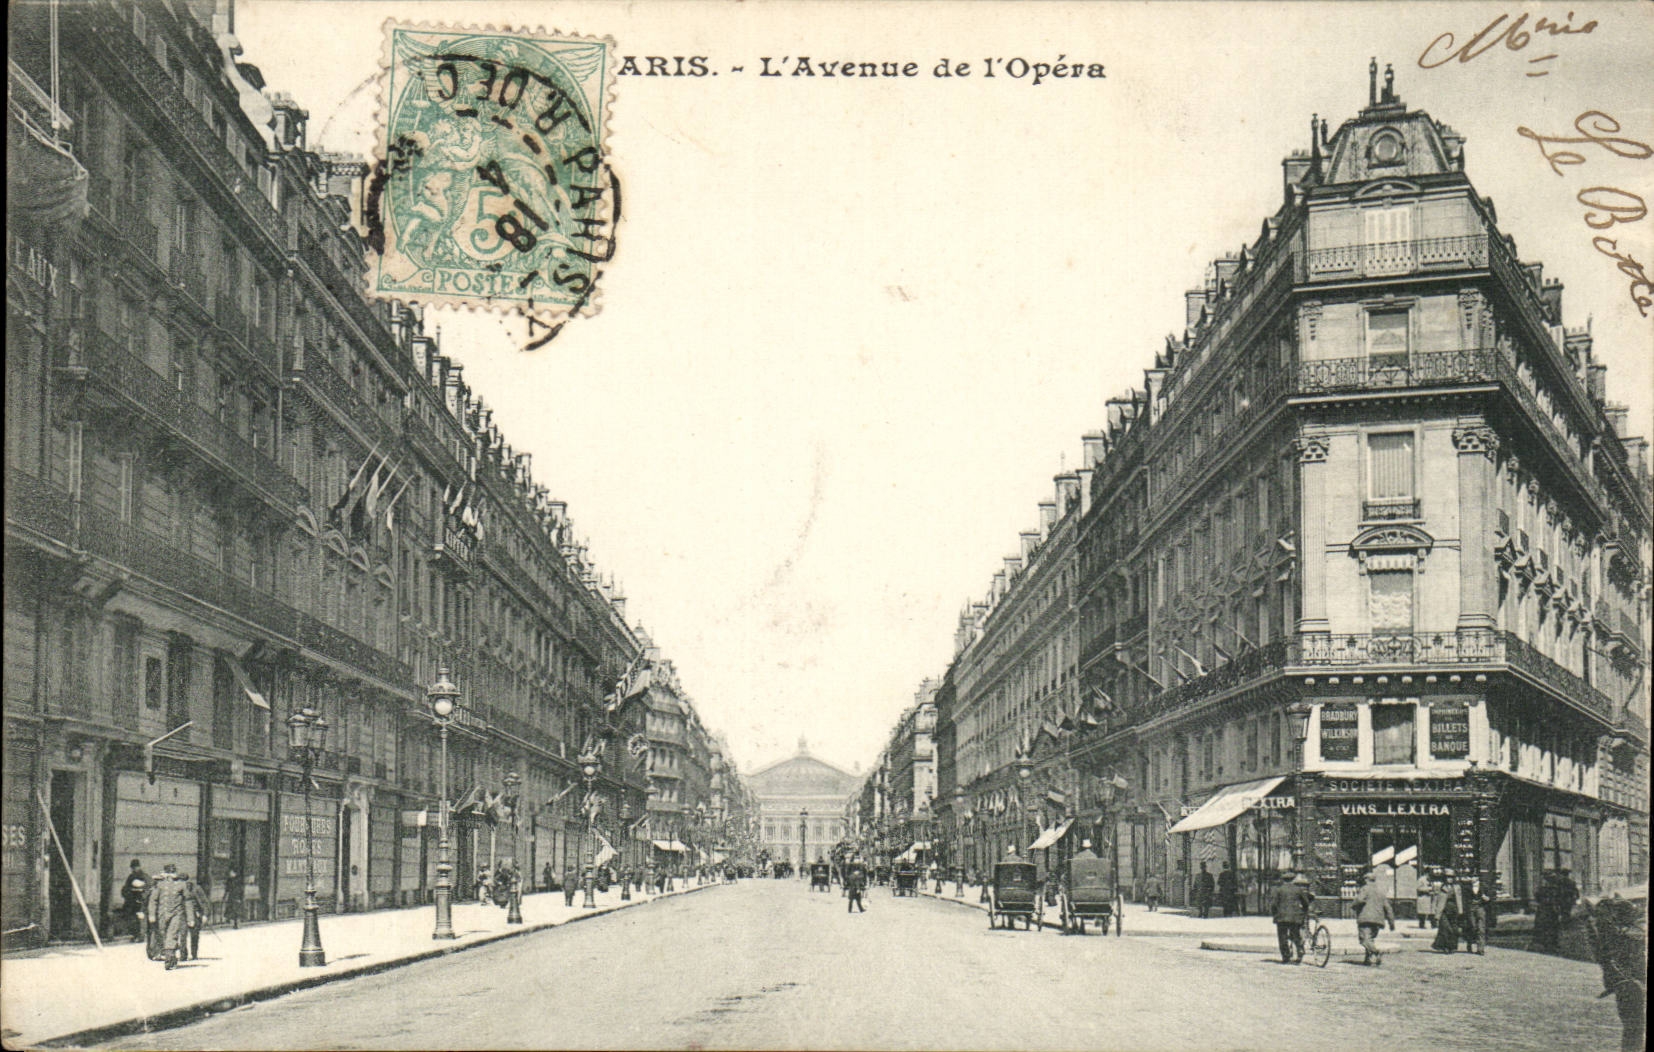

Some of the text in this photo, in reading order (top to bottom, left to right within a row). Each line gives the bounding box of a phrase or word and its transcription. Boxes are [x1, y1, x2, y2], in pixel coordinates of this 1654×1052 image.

[436, 269, 529, 296] POSTES
[1321, 710, 1359, 721] BRADBURY
[1431, 723, 1468, 733] BILLETS
[1431, 741, 1469, 752] BANQUE
[1341, 803, 1450, 816] VINS LEXTRA
[283, 815, 332, 834] FOURURES
[291, 838, 322, 855] ROES
